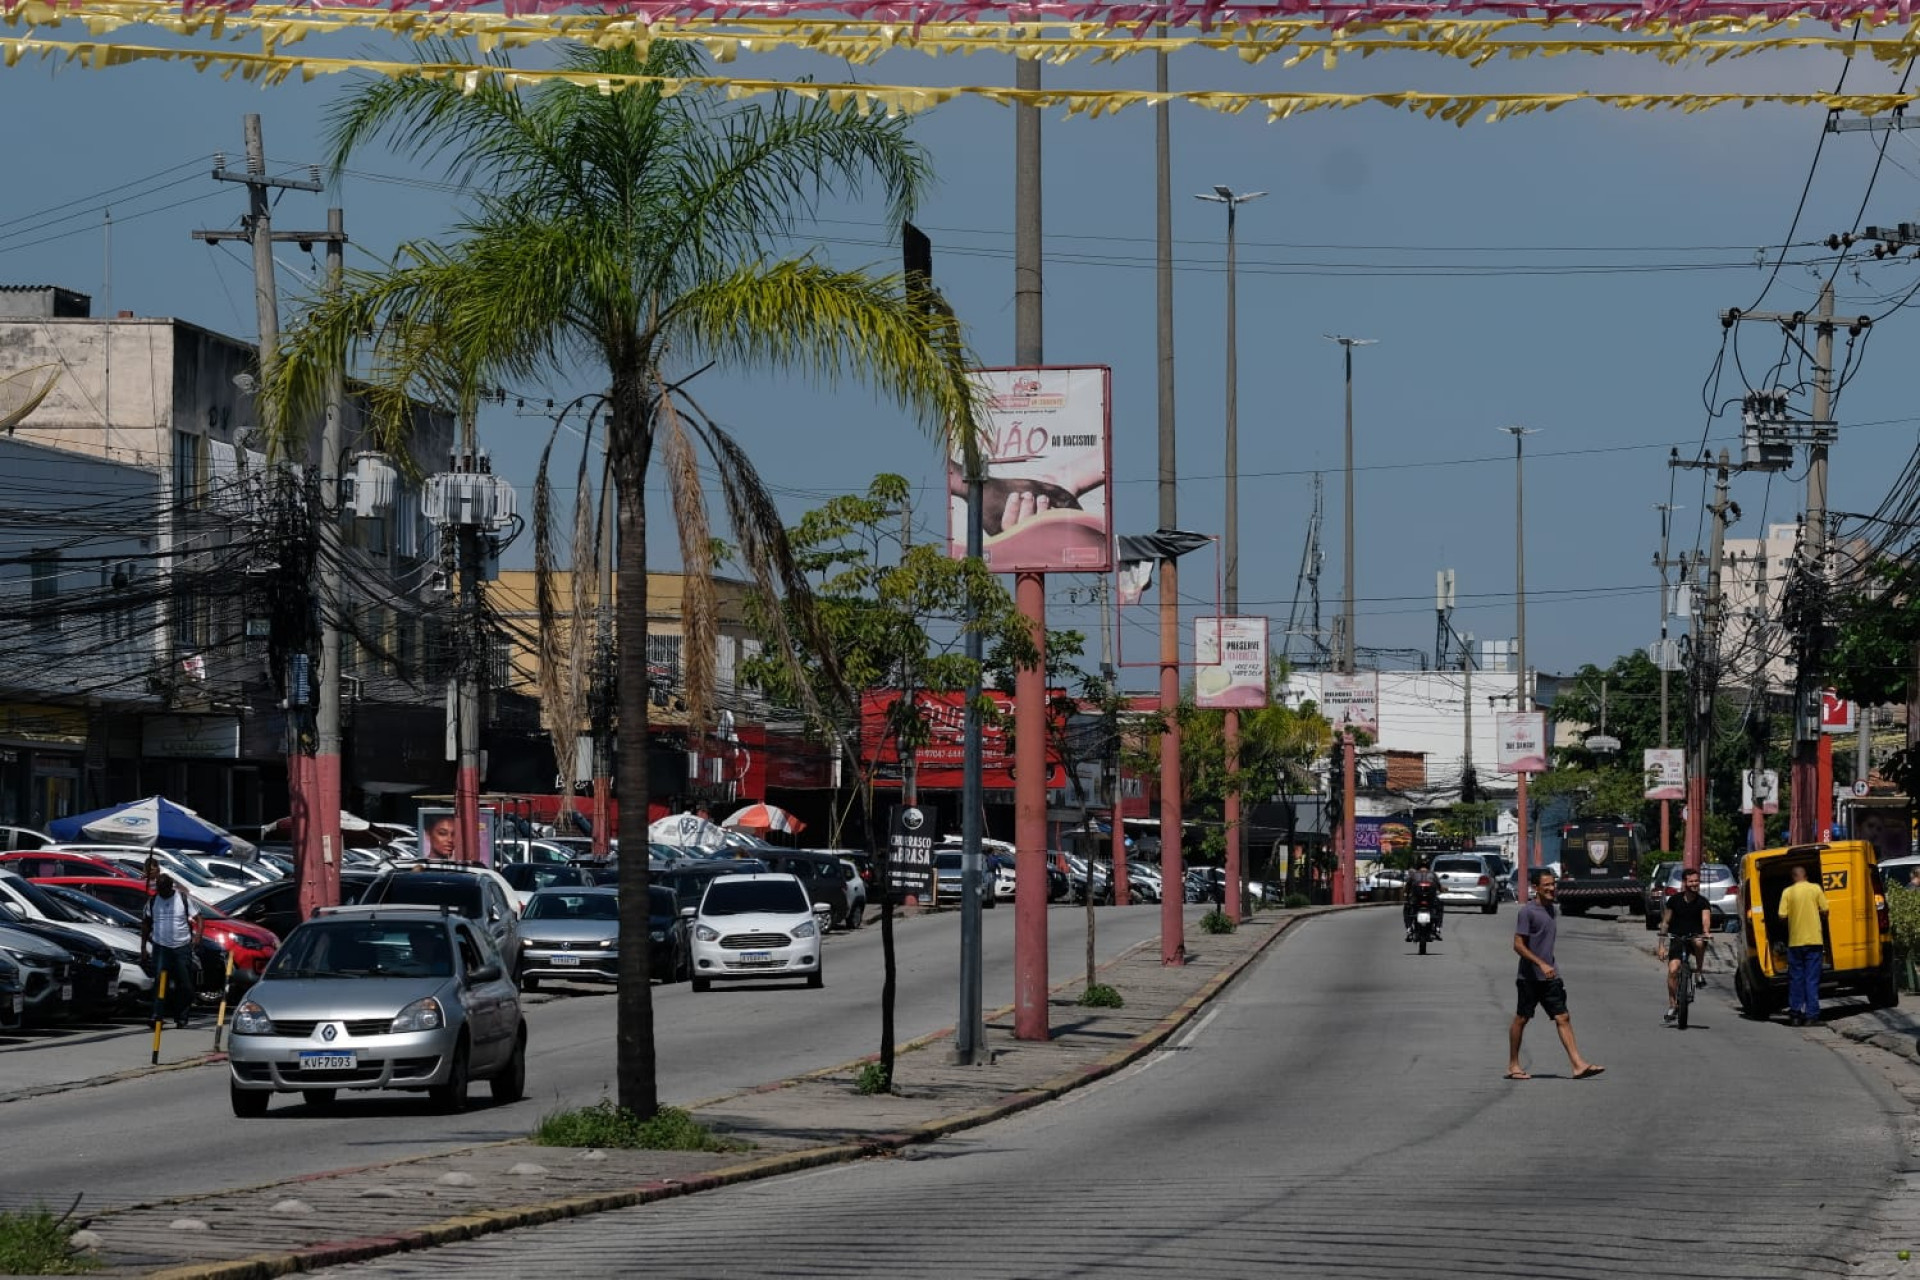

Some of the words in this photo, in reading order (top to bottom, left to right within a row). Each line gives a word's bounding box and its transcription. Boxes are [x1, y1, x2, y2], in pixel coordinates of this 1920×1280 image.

[979, 420, 1049, 455] NÃO
[1052, 435, 1061, 447] AO
[1063, 434, 1098, 447] RACISMO!
[1226, 640, 1259, 651] PRESERVE
[898, 846, 931, 865] BRASA
